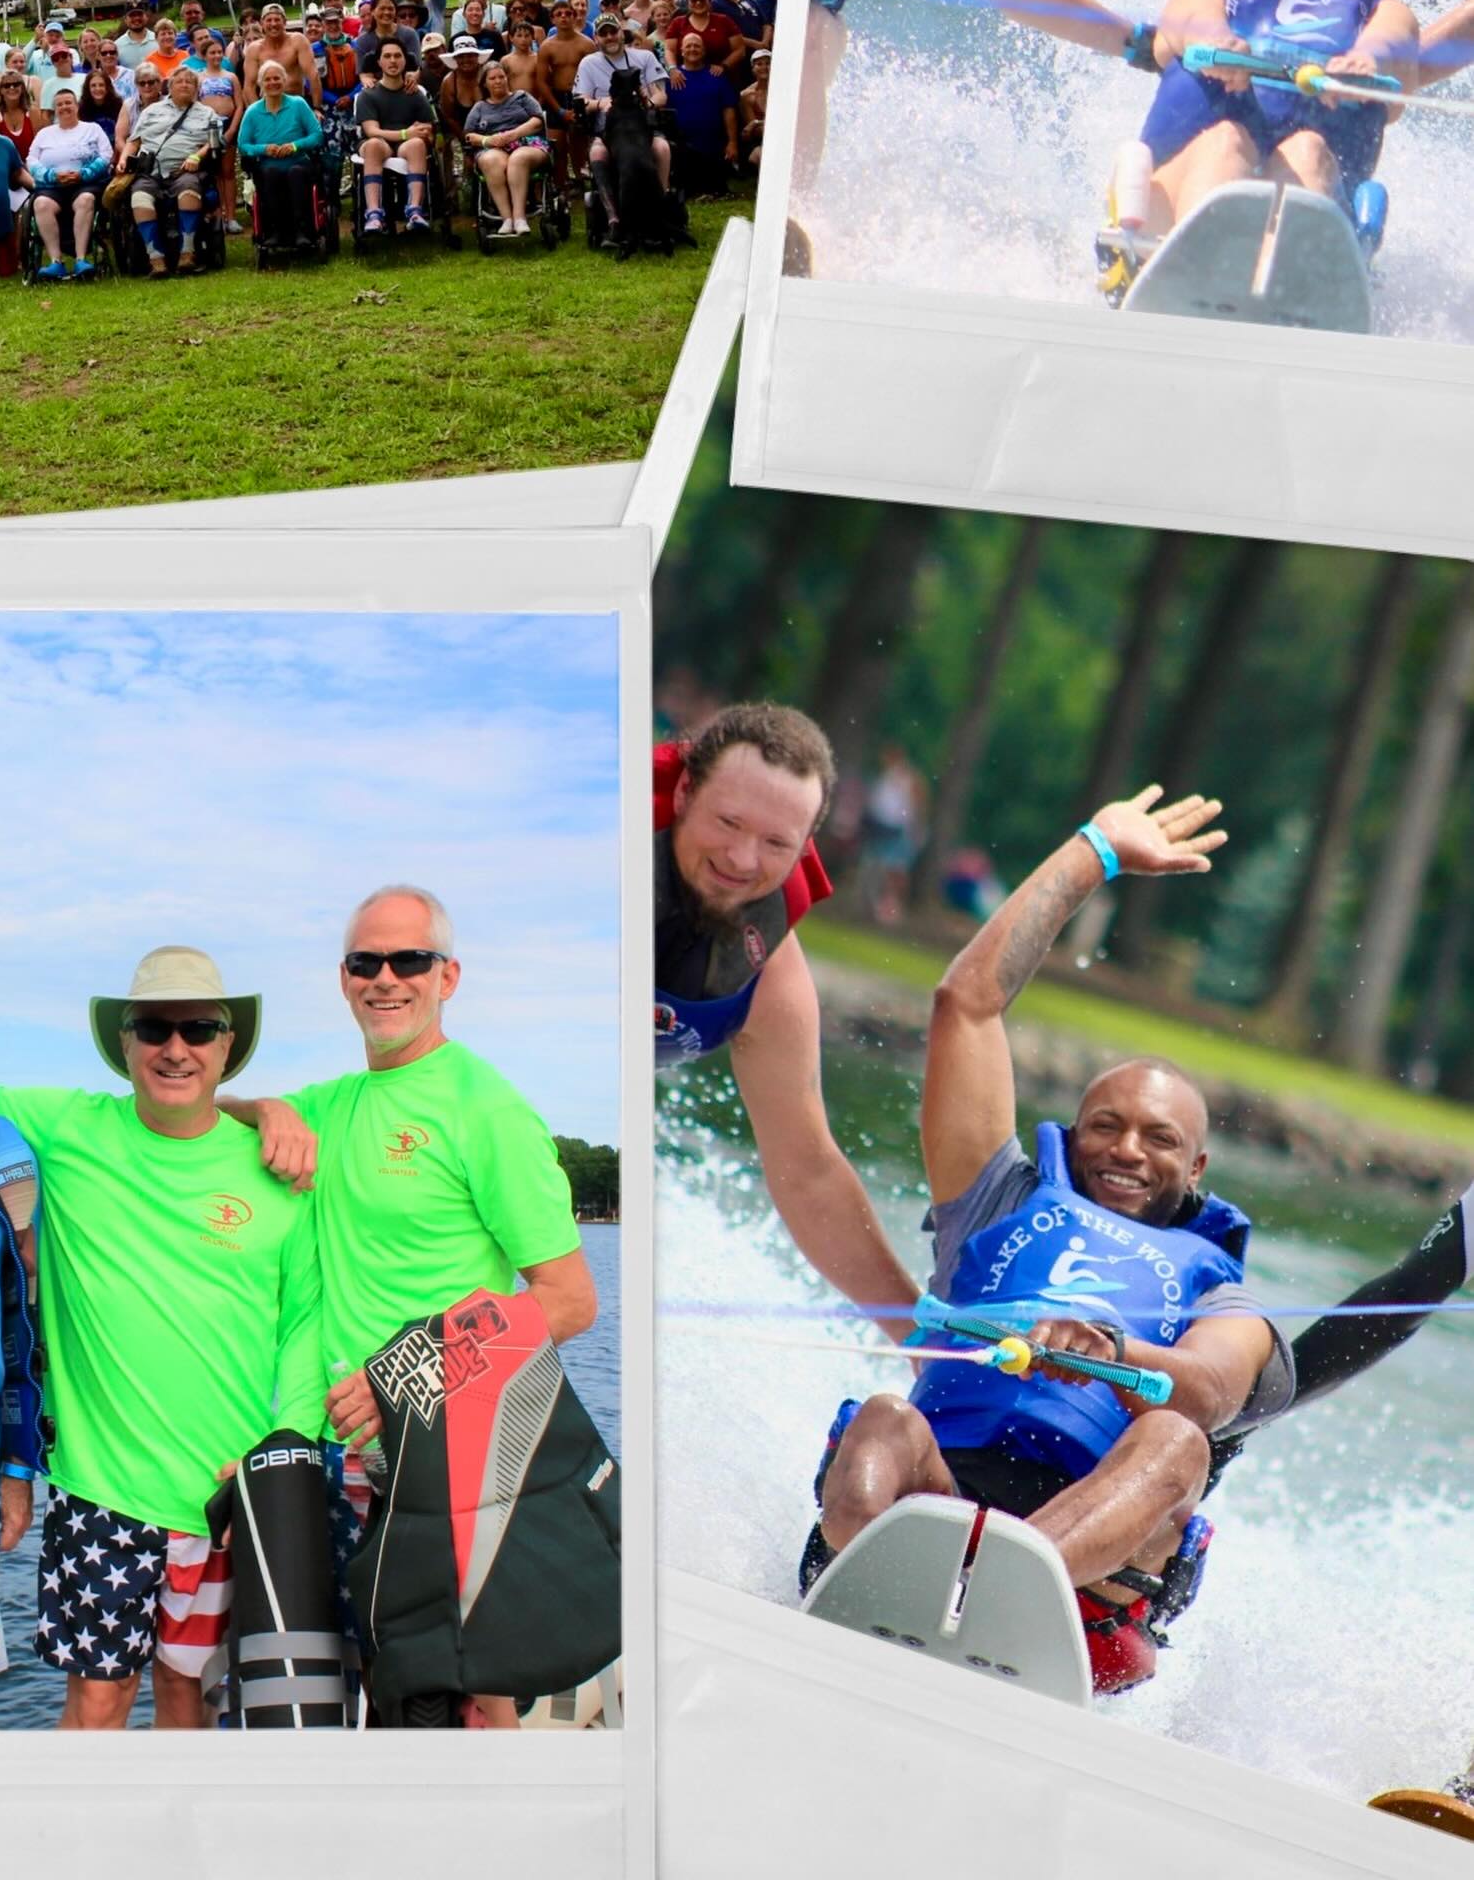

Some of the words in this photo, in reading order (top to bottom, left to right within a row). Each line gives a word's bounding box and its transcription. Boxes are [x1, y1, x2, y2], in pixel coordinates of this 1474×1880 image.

[981, 1227, 1033, 1294] LAKE
[1032, 1204, 1070, 1233] OF
[1075, 1207, 1135, 1246] THE
[1137, 1241, 1182, 1342] WOODS
[369, 1329, 438, 1394] BODY
[250, 1448, 323, 1472] OBRIE
